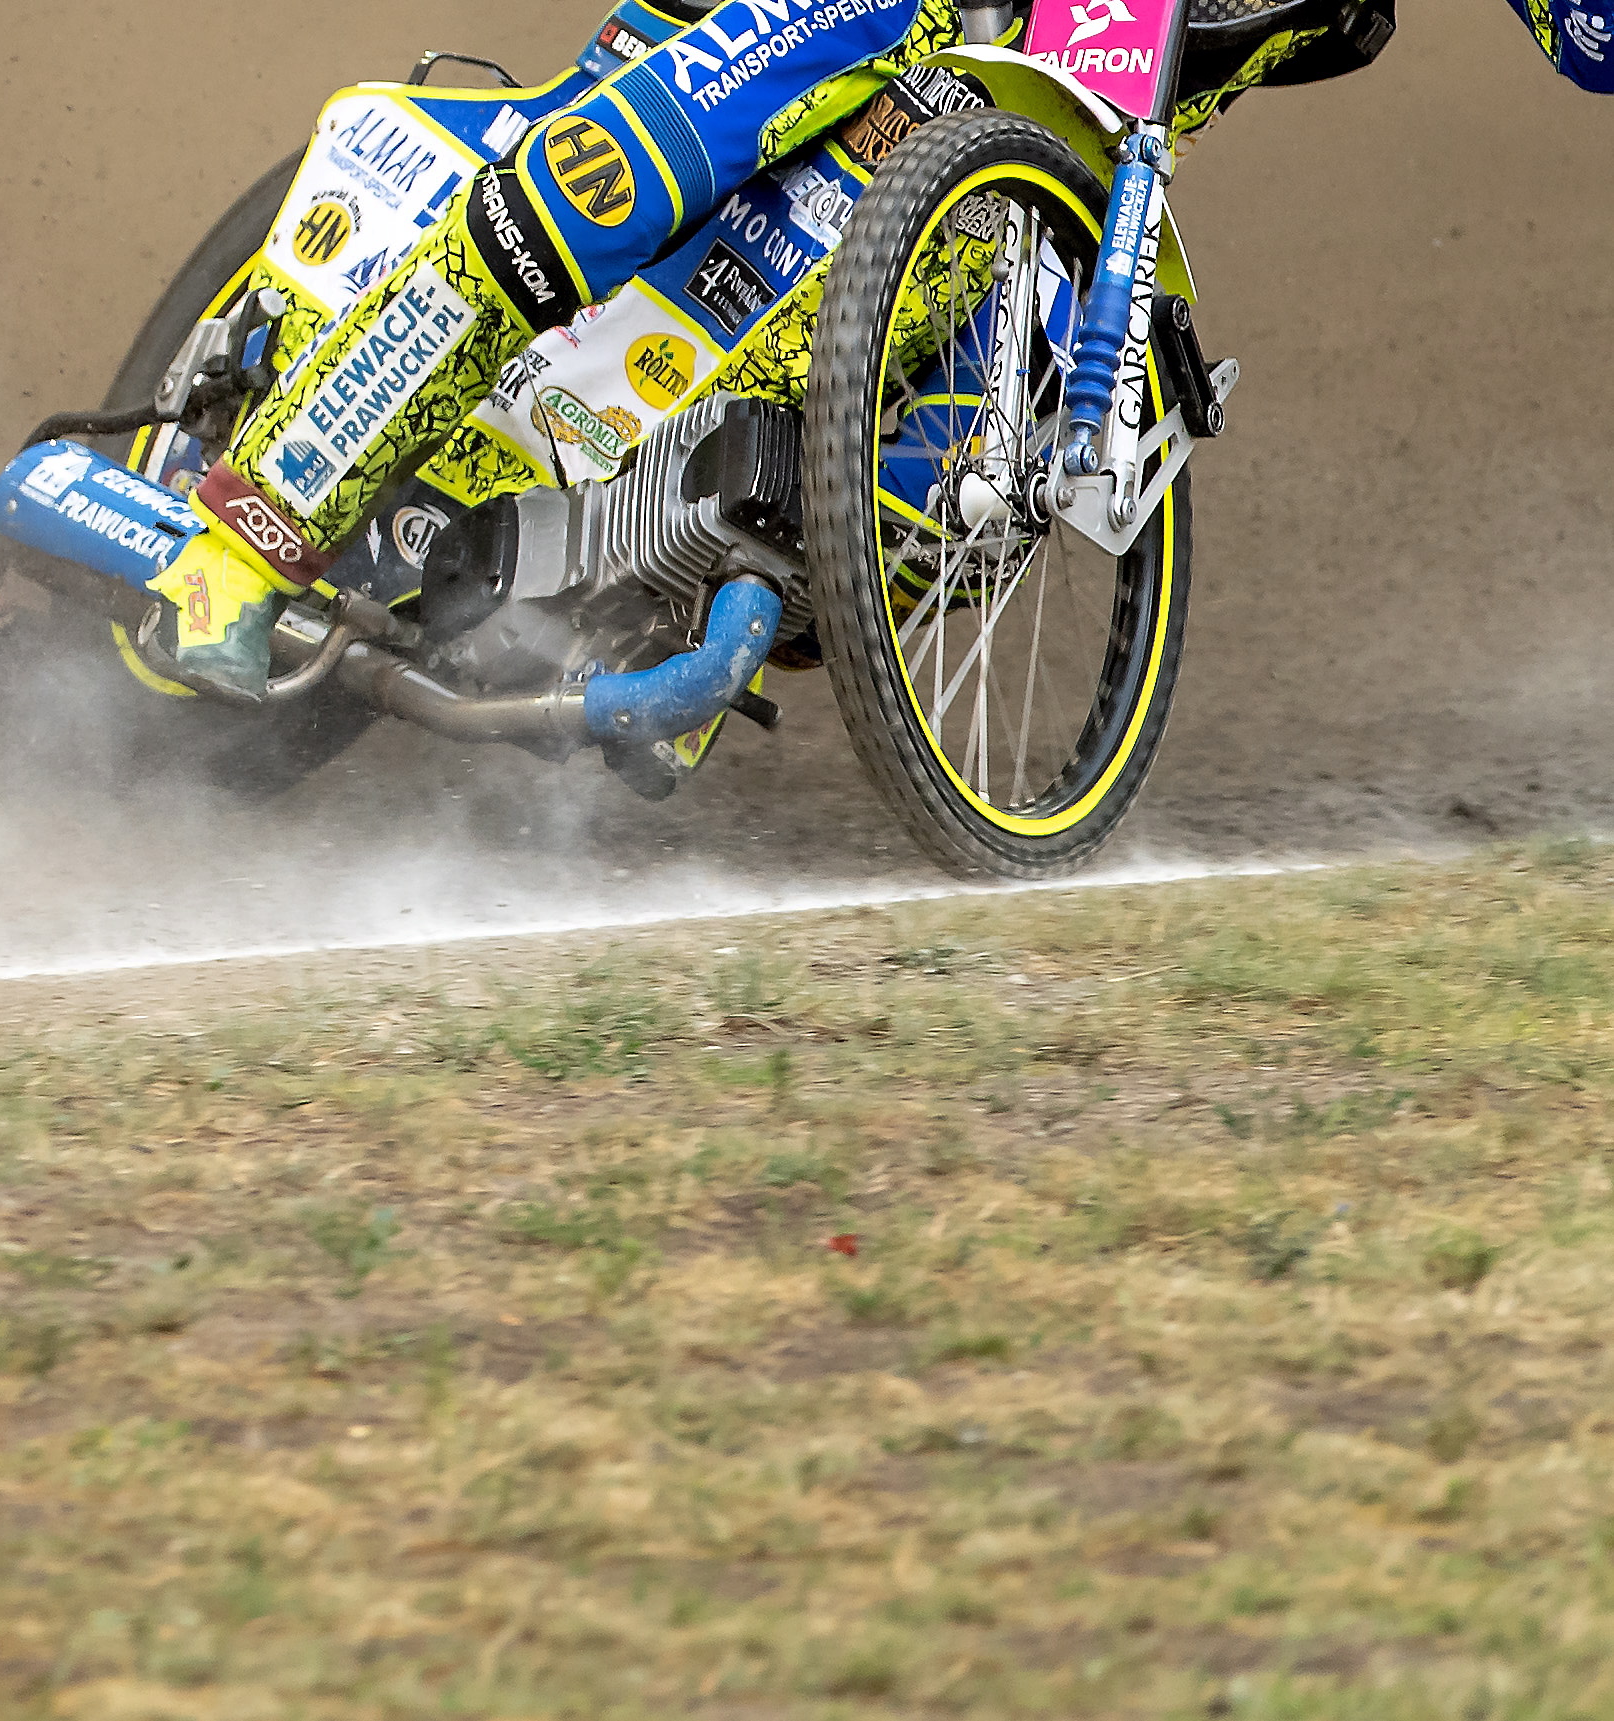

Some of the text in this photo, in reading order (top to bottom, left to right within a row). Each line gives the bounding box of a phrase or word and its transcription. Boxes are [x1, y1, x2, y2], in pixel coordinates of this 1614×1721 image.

[337, 108, 436, 193] ALMAR
[549, 121, 633, 219] HN
[295, 207, 349, 262] HN
[481, 164, 556, 305] TRANS-KOM
[307, 285, 437, 436] ELEWACJE-
[1118, 220, 1162, 430] GARCAREK
[330, 304, 465, 458] PRAWUCKI.PL
[545, 391, 624, 455] AGROMIX
[225, 495, 303, 563] Fogo
